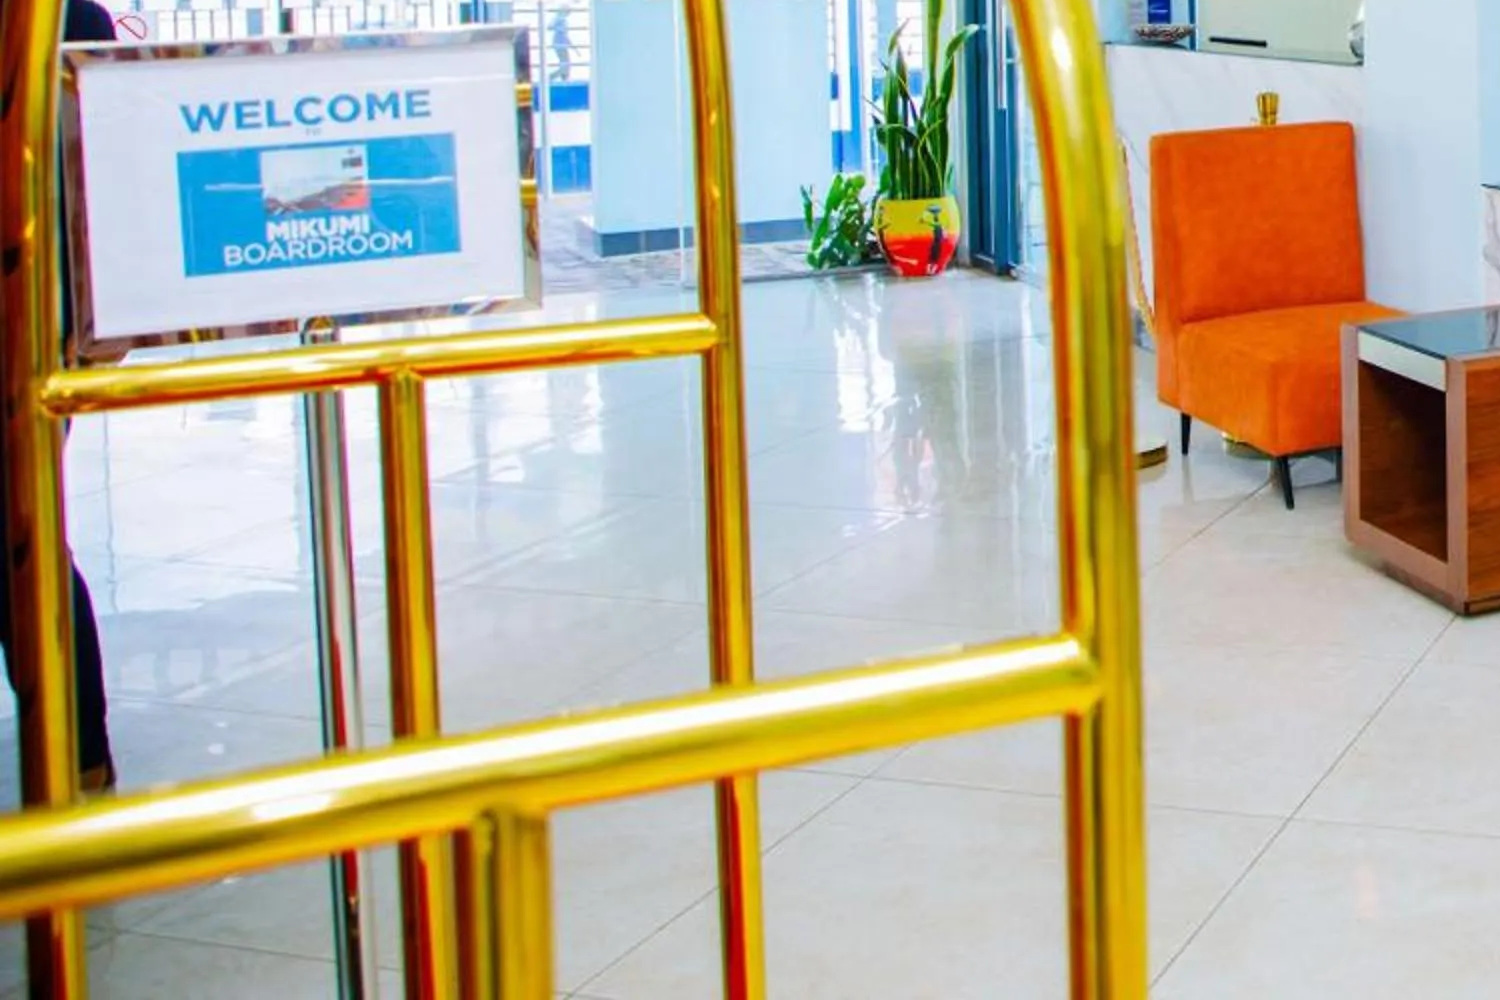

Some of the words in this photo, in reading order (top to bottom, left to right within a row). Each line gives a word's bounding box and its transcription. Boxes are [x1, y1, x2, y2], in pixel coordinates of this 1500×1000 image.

[180, 89, 431, 134] WELCOME
[266, 213, 371, 242] MIKUMI
[223, 230, 413, 266] BOARDROOM
